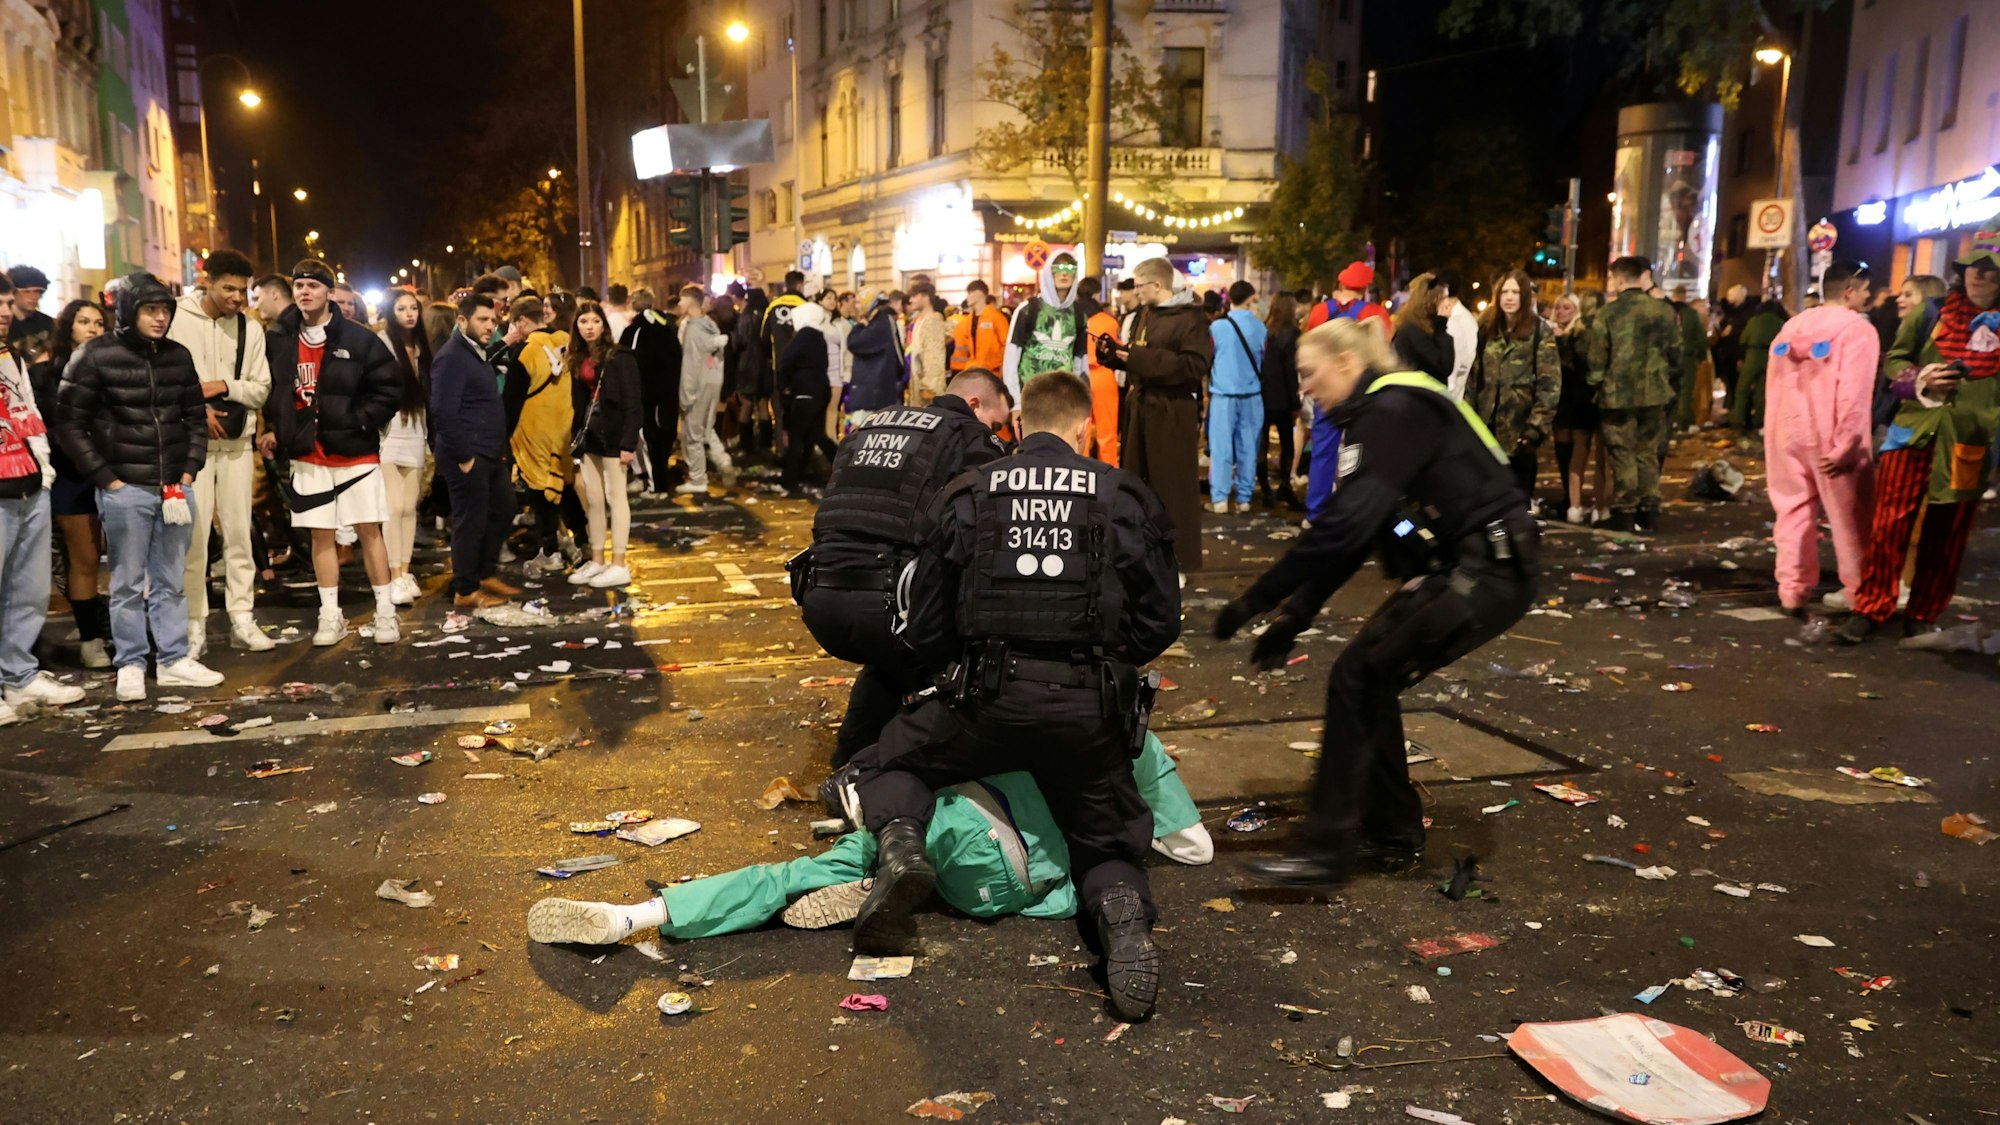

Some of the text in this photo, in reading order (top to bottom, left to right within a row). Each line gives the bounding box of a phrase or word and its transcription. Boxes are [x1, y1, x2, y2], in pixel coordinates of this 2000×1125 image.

[860, 410, 943, 430] POLIZEI
[863, 433, 910, 451] NRW
[854, 449, 902, 468] 31413
[989, 467, 1096, 495] POLIZEI
[1011, 498, 1073, 523] NRW
[1007, 526, 1073, 551] 31413
